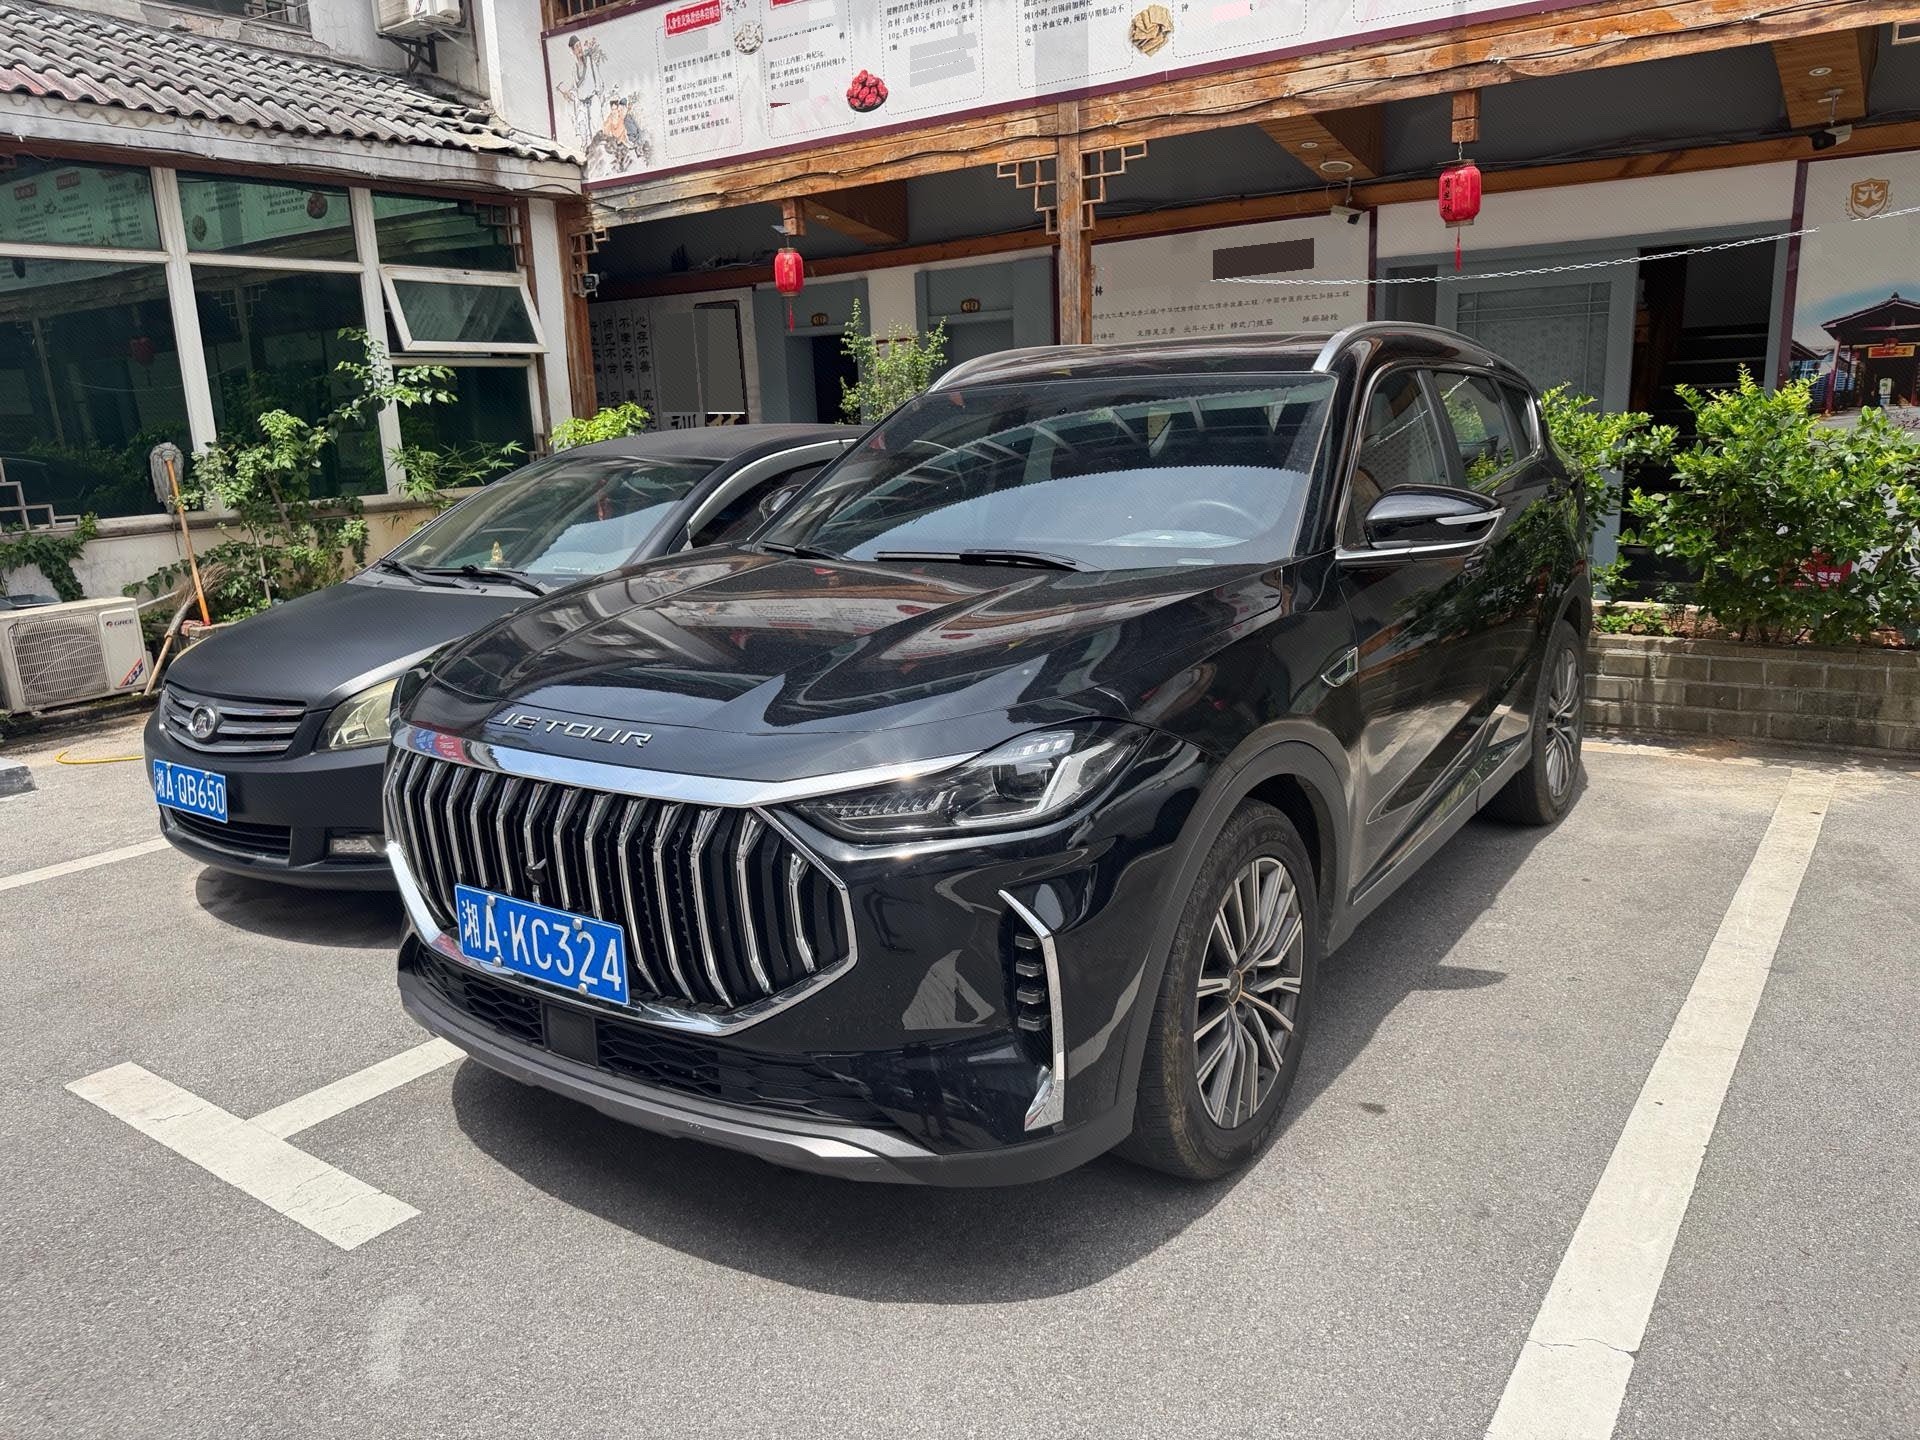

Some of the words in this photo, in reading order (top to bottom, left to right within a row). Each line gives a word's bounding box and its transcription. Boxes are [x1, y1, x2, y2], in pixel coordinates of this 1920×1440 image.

[502, 712, 652, 747] JETOUR
[156, 768, 225, 815] 湘A·QB650
[461, 898, 622, 992] 湘A·KC324
